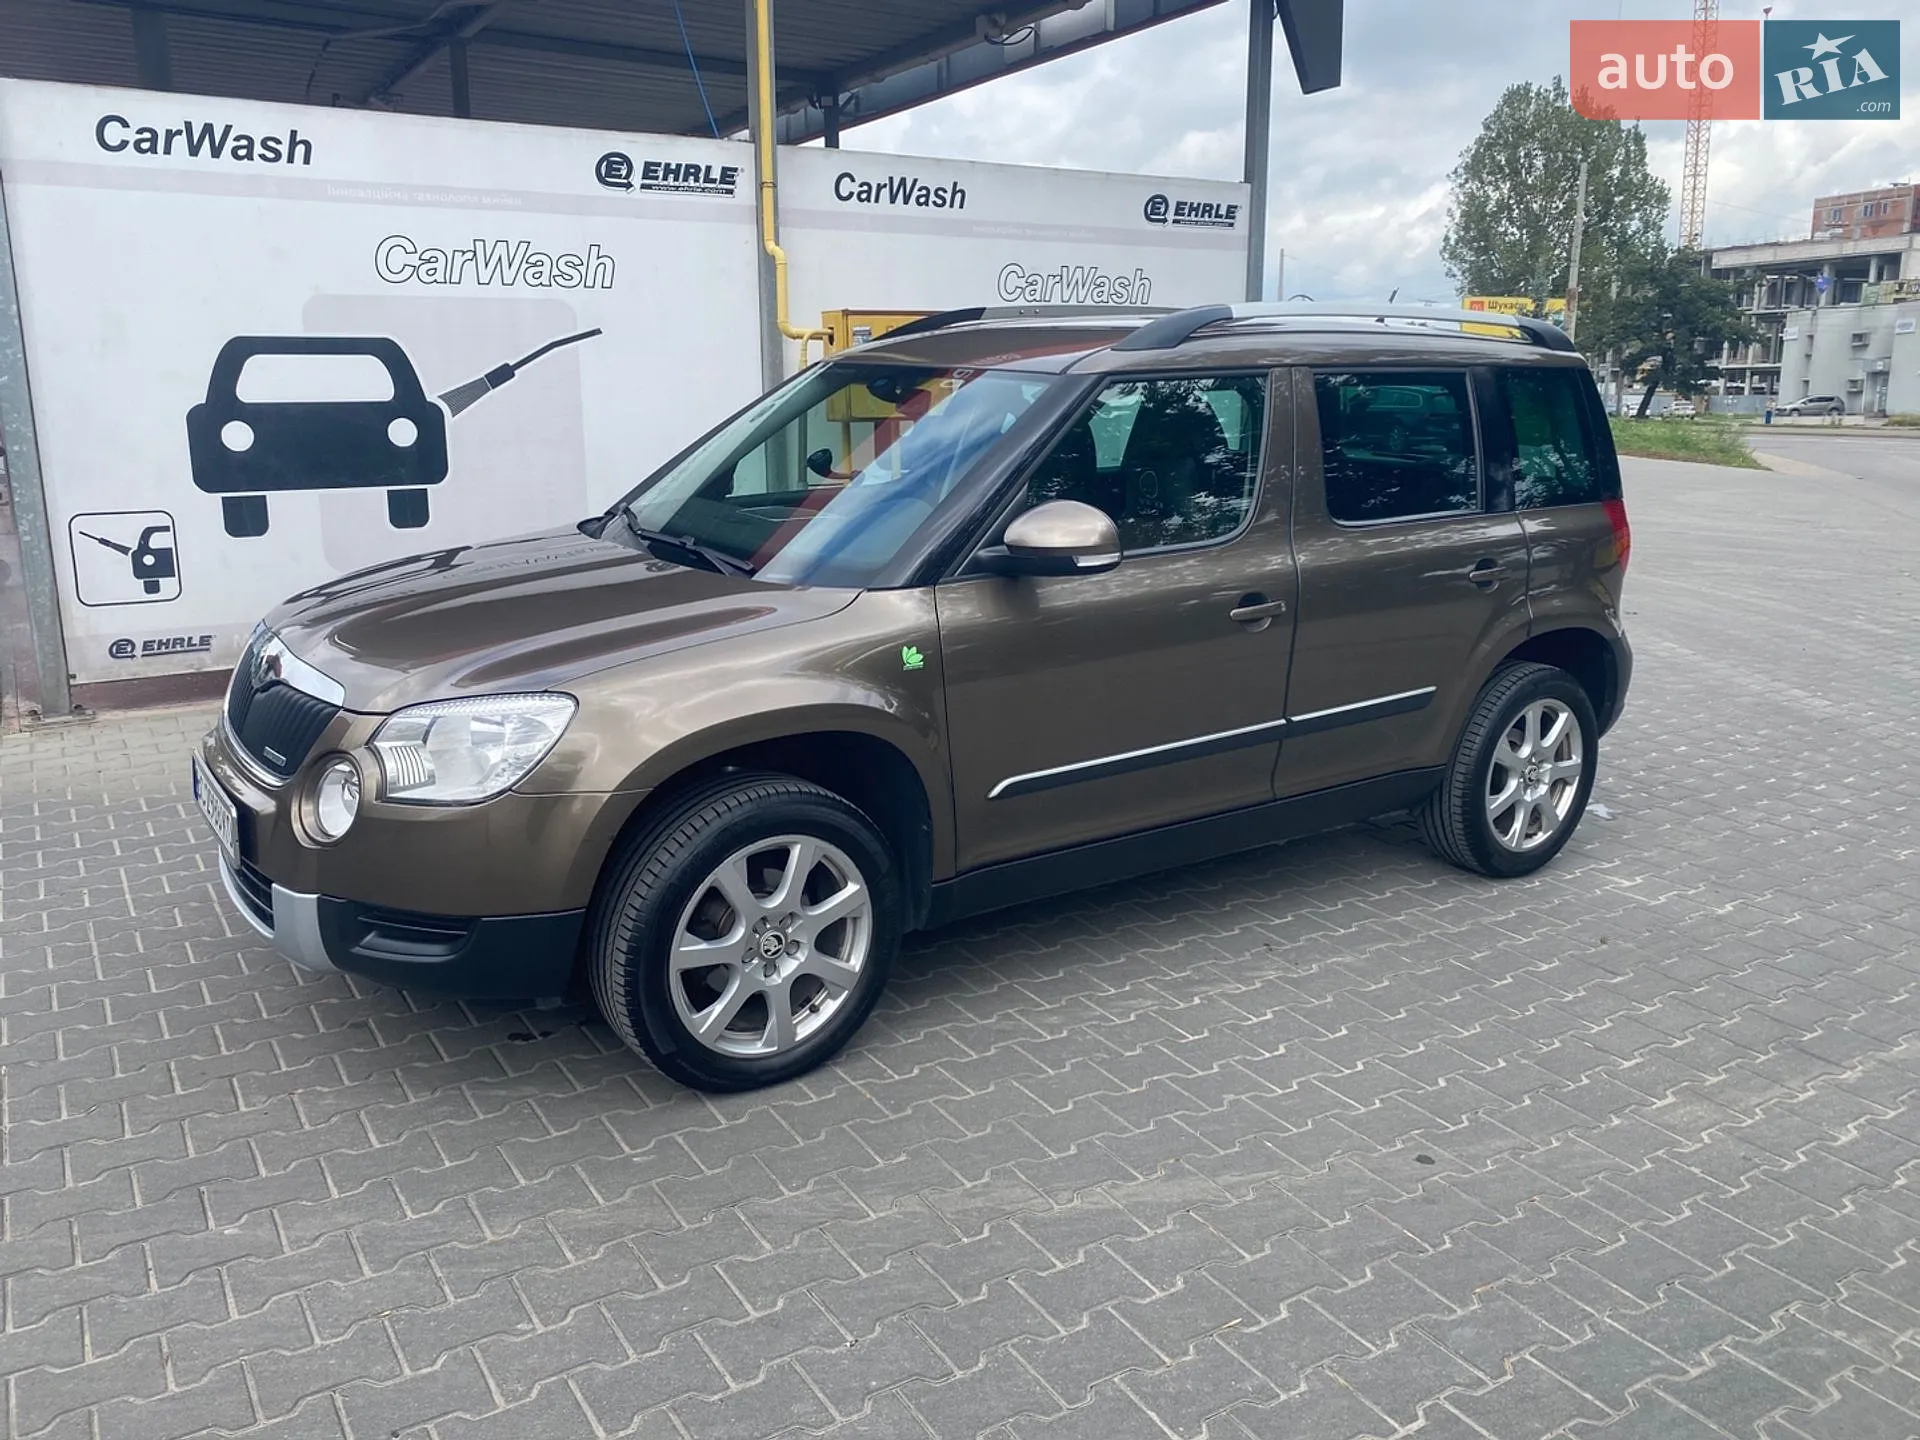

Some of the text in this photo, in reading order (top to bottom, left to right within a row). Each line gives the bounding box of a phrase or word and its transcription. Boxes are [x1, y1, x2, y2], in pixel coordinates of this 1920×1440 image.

[95, 114, 313, 166] CarWash
[641, 161, 739, 186] EHRLE
[834, 172, 967, 209] CarWash
[1173, 200, 1239, 220] EHRLE
[374, 235, 616, 289] CarWash
[998, 263, 1152, 305] CarWash
[141, 635, 213, 652] EHRLE
